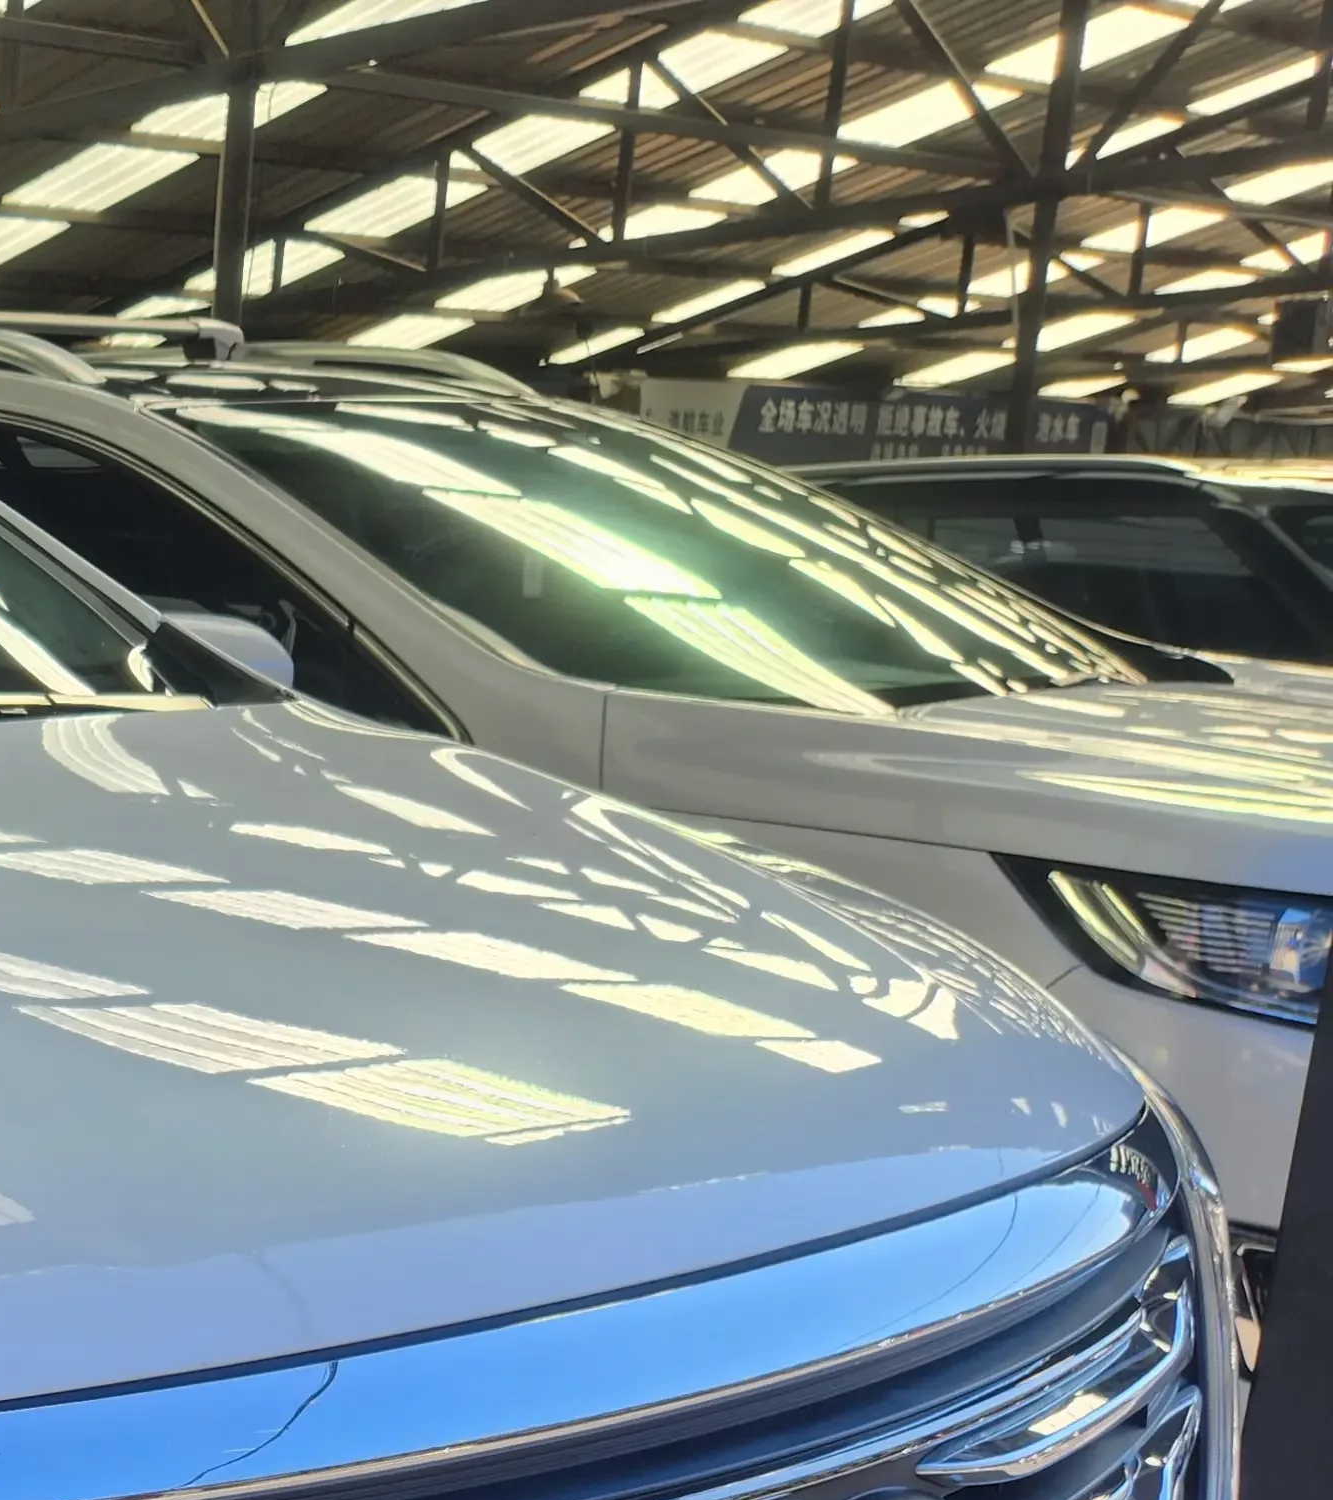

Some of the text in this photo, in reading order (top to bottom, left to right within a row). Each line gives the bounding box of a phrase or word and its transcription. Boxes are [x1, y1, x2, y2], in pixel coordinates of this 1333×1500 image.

[759, 397, 867, 435] 全场车况透明
